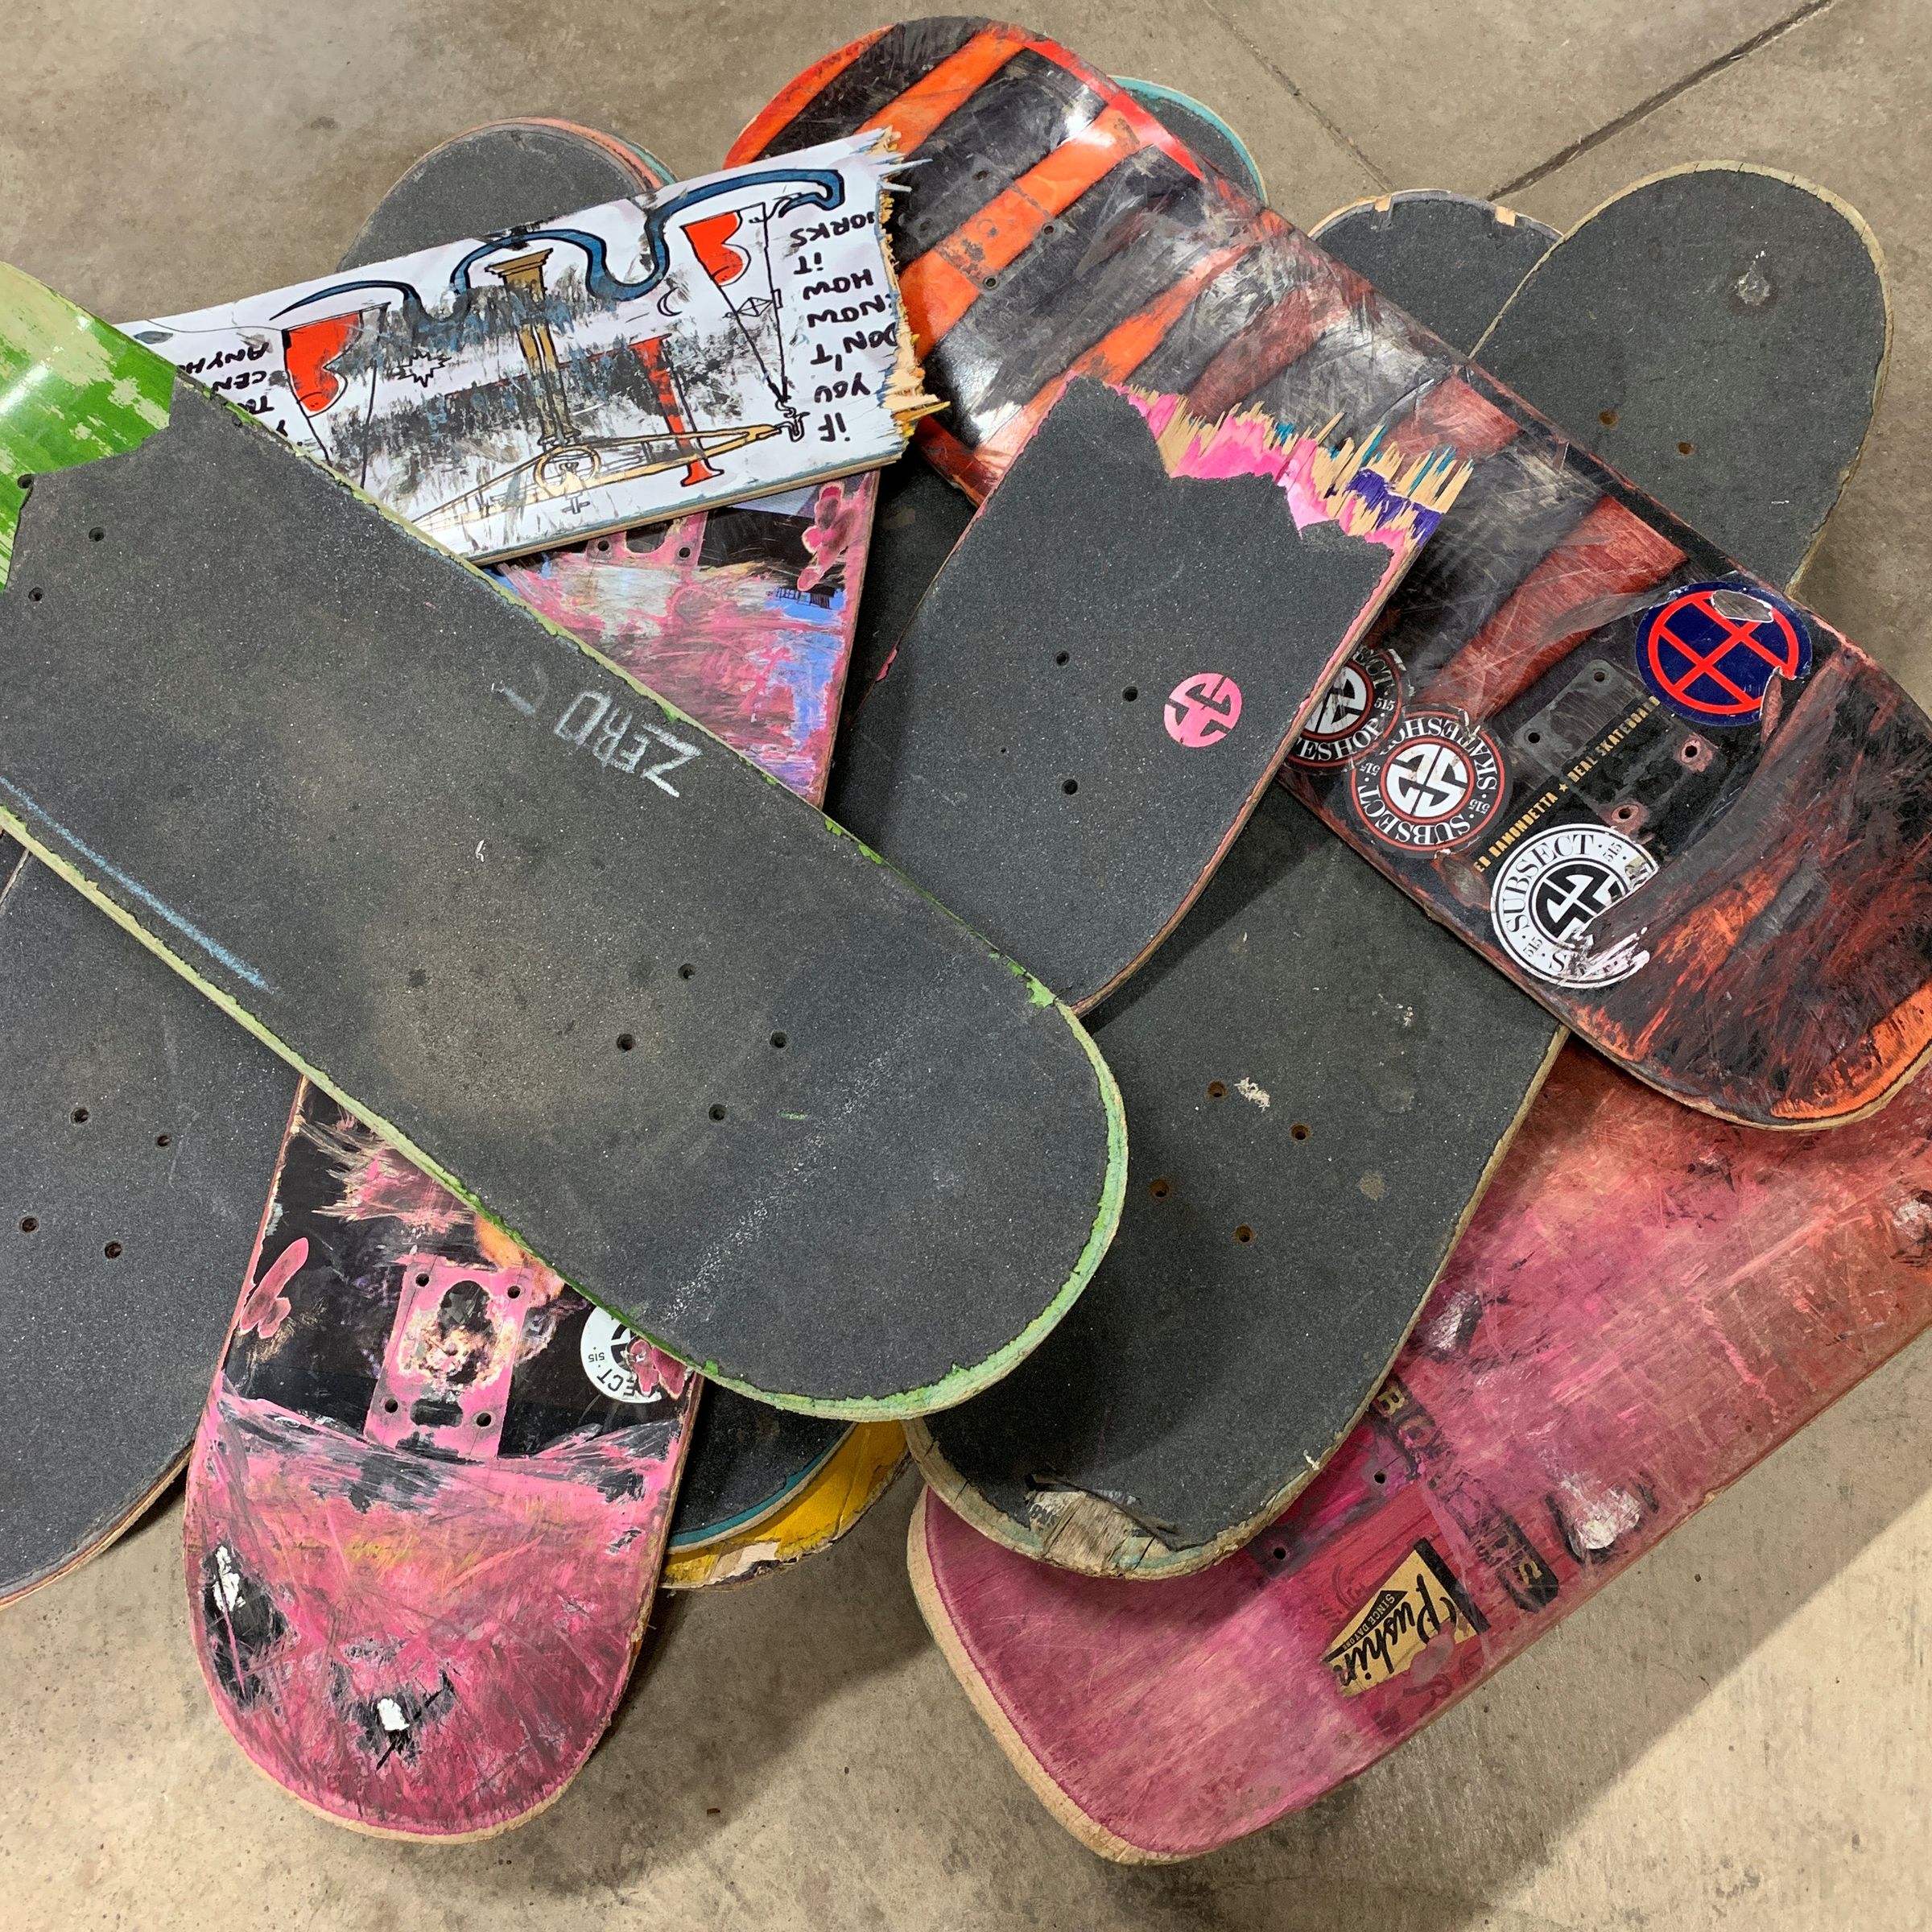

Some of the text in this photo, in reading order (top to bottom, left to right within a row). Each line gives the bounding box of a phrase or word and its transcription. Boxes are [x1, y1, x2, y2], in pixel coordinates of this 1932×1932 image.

[803, 268, 874, 300] HOW
[807, 293, 893, 328] NOW
[810, 322, 898, 372] DON'T
[1373, 697, 1396, 712] 515
[553, 690, 704, 798] ZERO
[1356, 784, 1472, 845] SUBSECT
[1468, 798, 1491, 815] 515
[1603, 841, 1624, 863] 515
[1502, 833, 1595, 933] SUBSECT
[1522, 936, 1545, 958] 515
[588, 1352, 606, 1363] 515
[1368, 1593, 1396, 1625] SINCE
[1353, 1623, 1369, 1640] DAY
